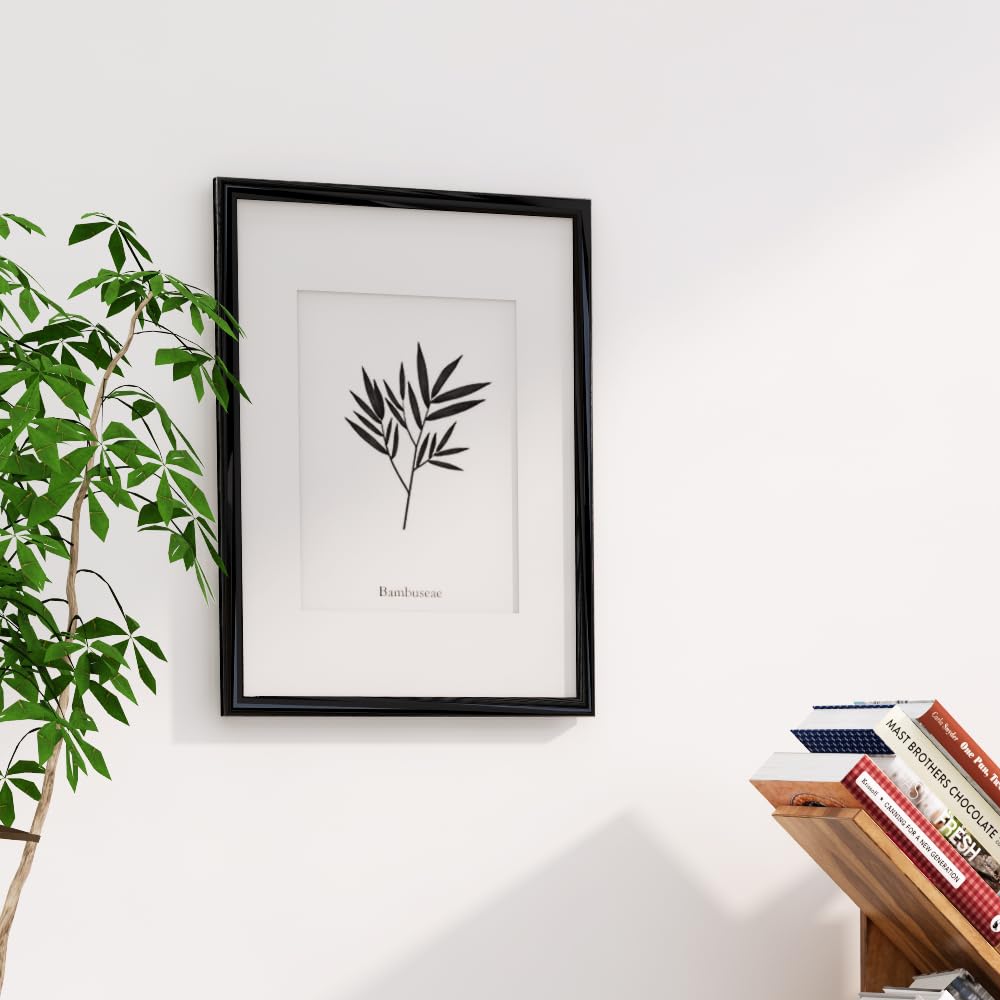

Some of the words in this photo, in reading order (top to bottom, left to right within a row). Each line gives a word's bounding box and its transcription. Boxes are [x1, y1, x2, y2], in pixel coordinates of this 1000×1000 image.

[378, 585, 443, 598] Bambuseae
[931, 711, 944, 726] Carla
[942, 723, 959, 741] Snyder
[885, 719, 911, 743] MAST
[907, 742, 951, 788] BROTHERS
[949, 786, 998, 839] CHOCOLATE
[960, 742, 975, 758] One
[973, 756, 989, 777] Pan,
[884, 802, 906, 826] CANNING
[906, 824, 917, 836] FOR
[920, 839, 932, 852] NEW
[931, 851, 960, 882] GENERATION
[934, 811, 981, 861] FRESH
